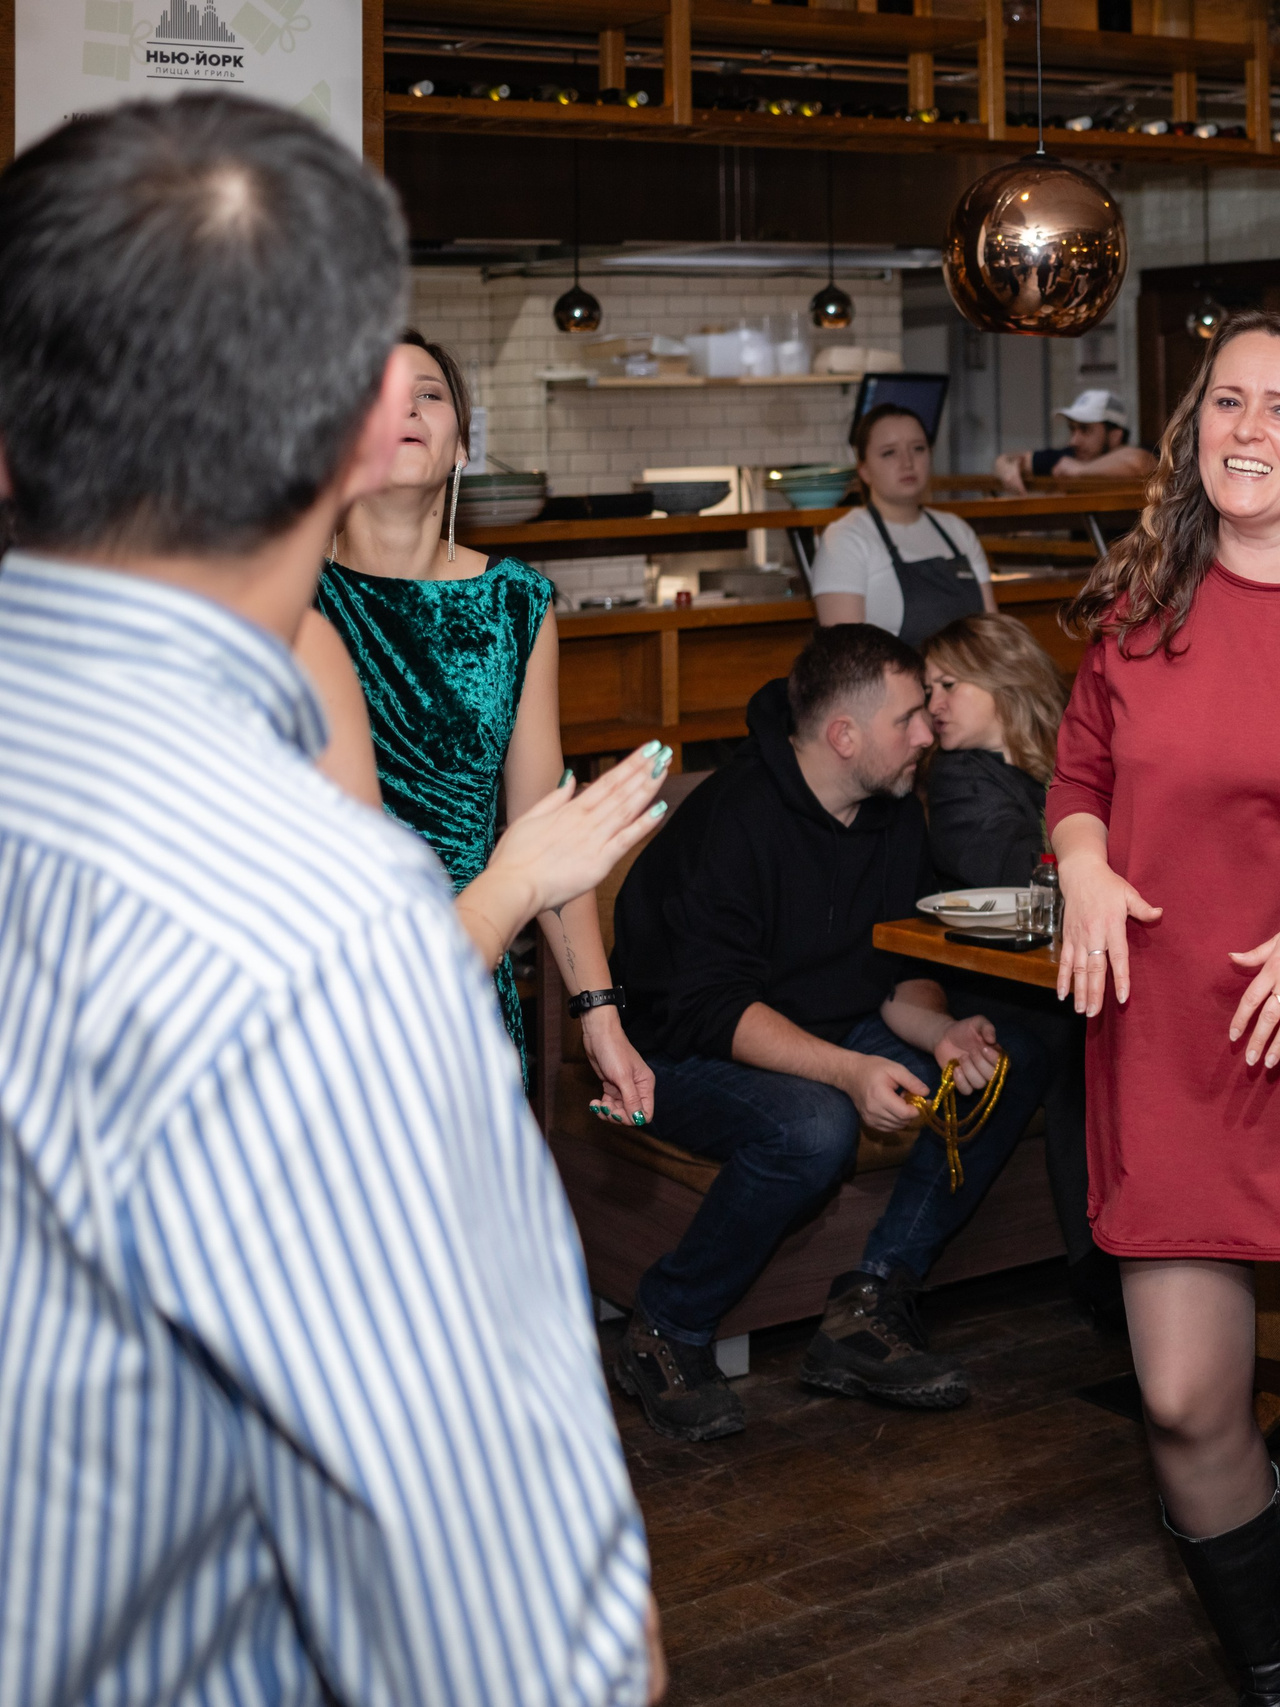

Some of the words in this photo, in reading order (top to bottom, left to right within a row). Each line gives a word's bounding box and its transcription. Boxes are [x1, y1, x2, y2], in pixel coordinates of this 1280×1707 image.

[146, 50, 244, 68] НЬЮ-ЙОРК
[155, 67, 189, 76] ПИЦЦА
[204, 70, 235, 78] ГРИЛЬ
